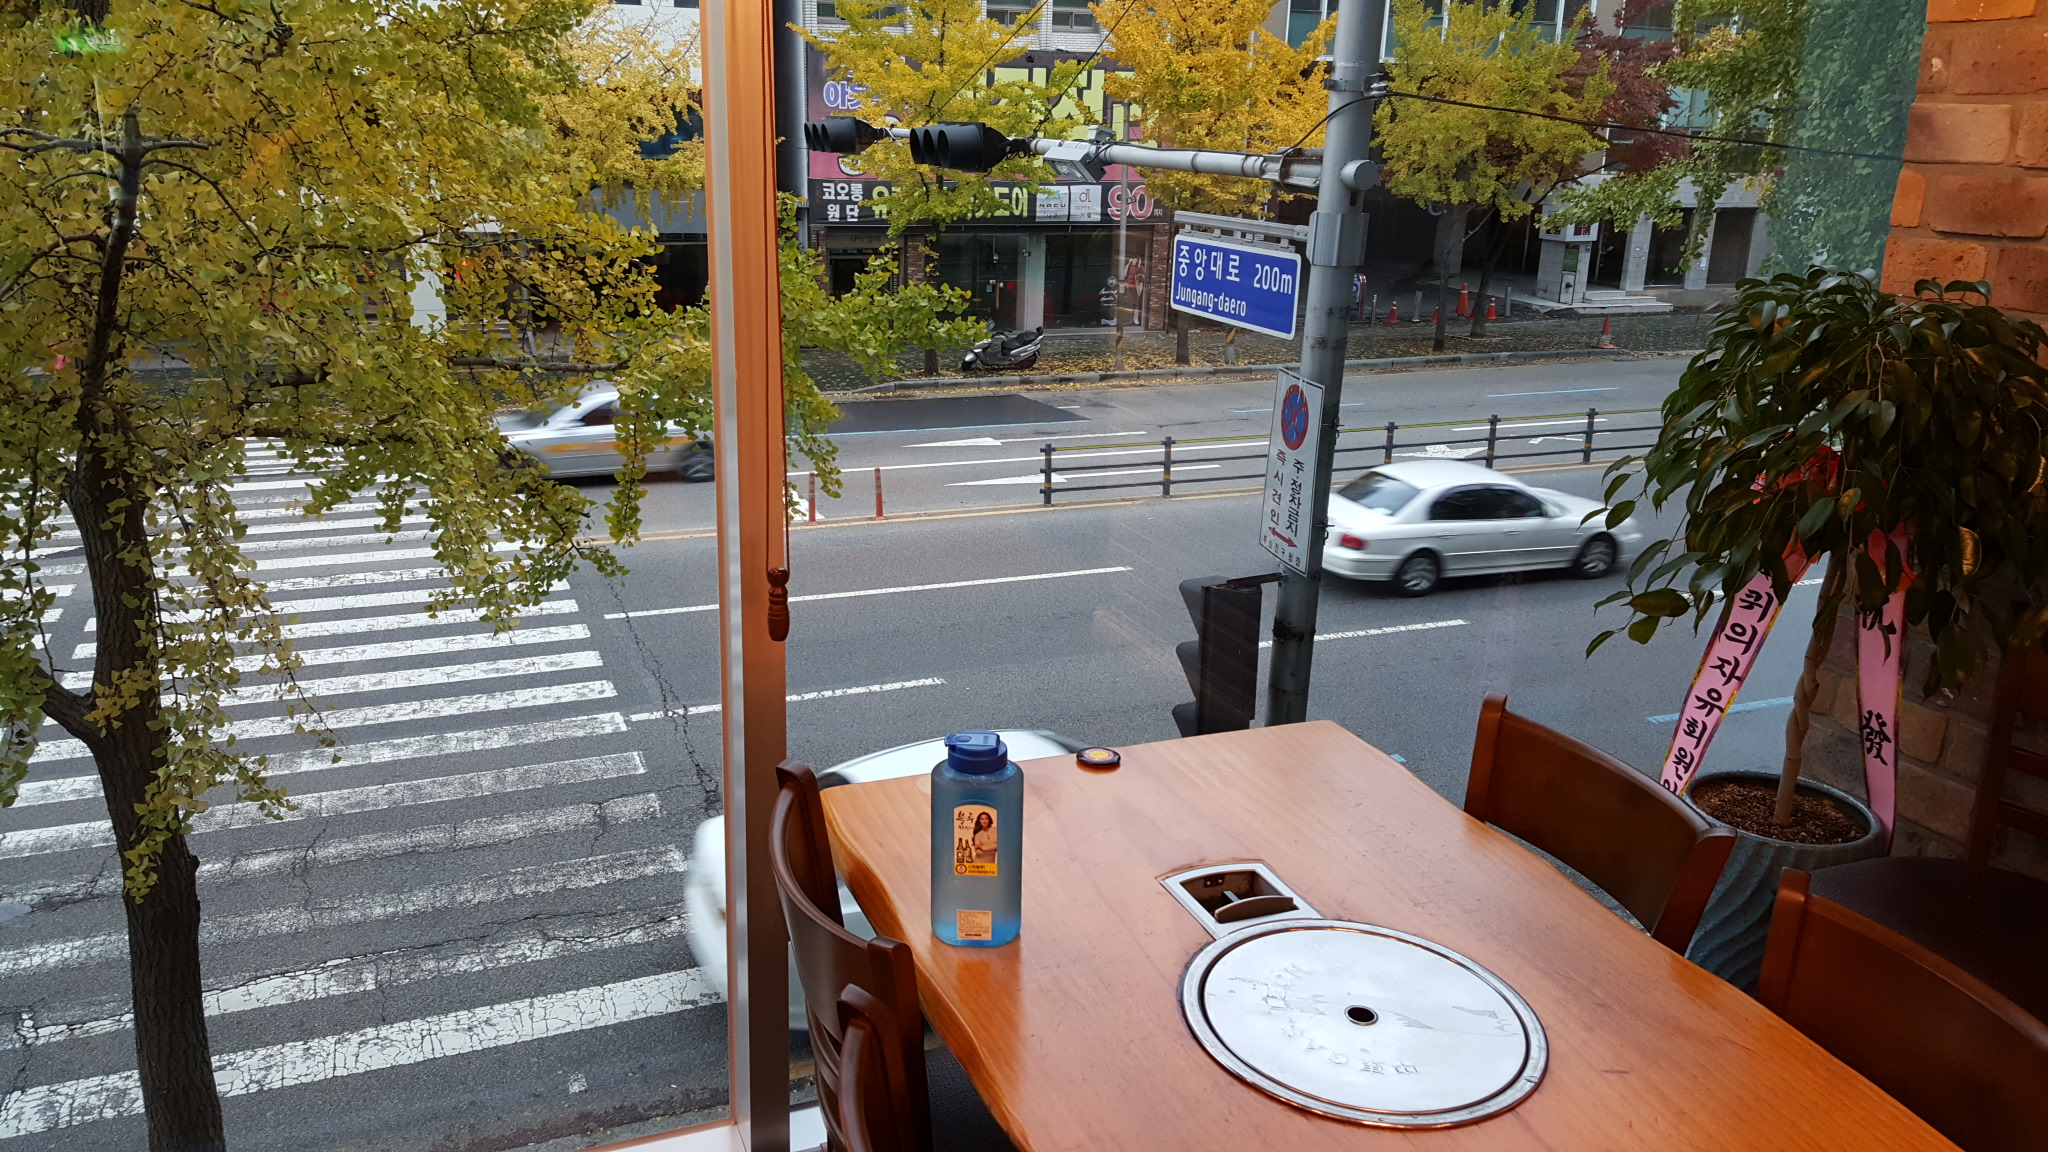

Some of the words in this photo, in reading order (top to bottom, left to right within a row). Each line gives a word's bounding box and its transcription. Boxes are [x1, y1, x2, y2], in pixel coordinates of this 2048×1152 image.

[822, 183, 863, 201] 코오롱
[1108, 185, 1154, 220] 90
[1178, 245, 1240, 282] 중앙대로
[1253, 263, 1293, 294] 200m
[1176, 282, 1247, 317] Jungang-daero
